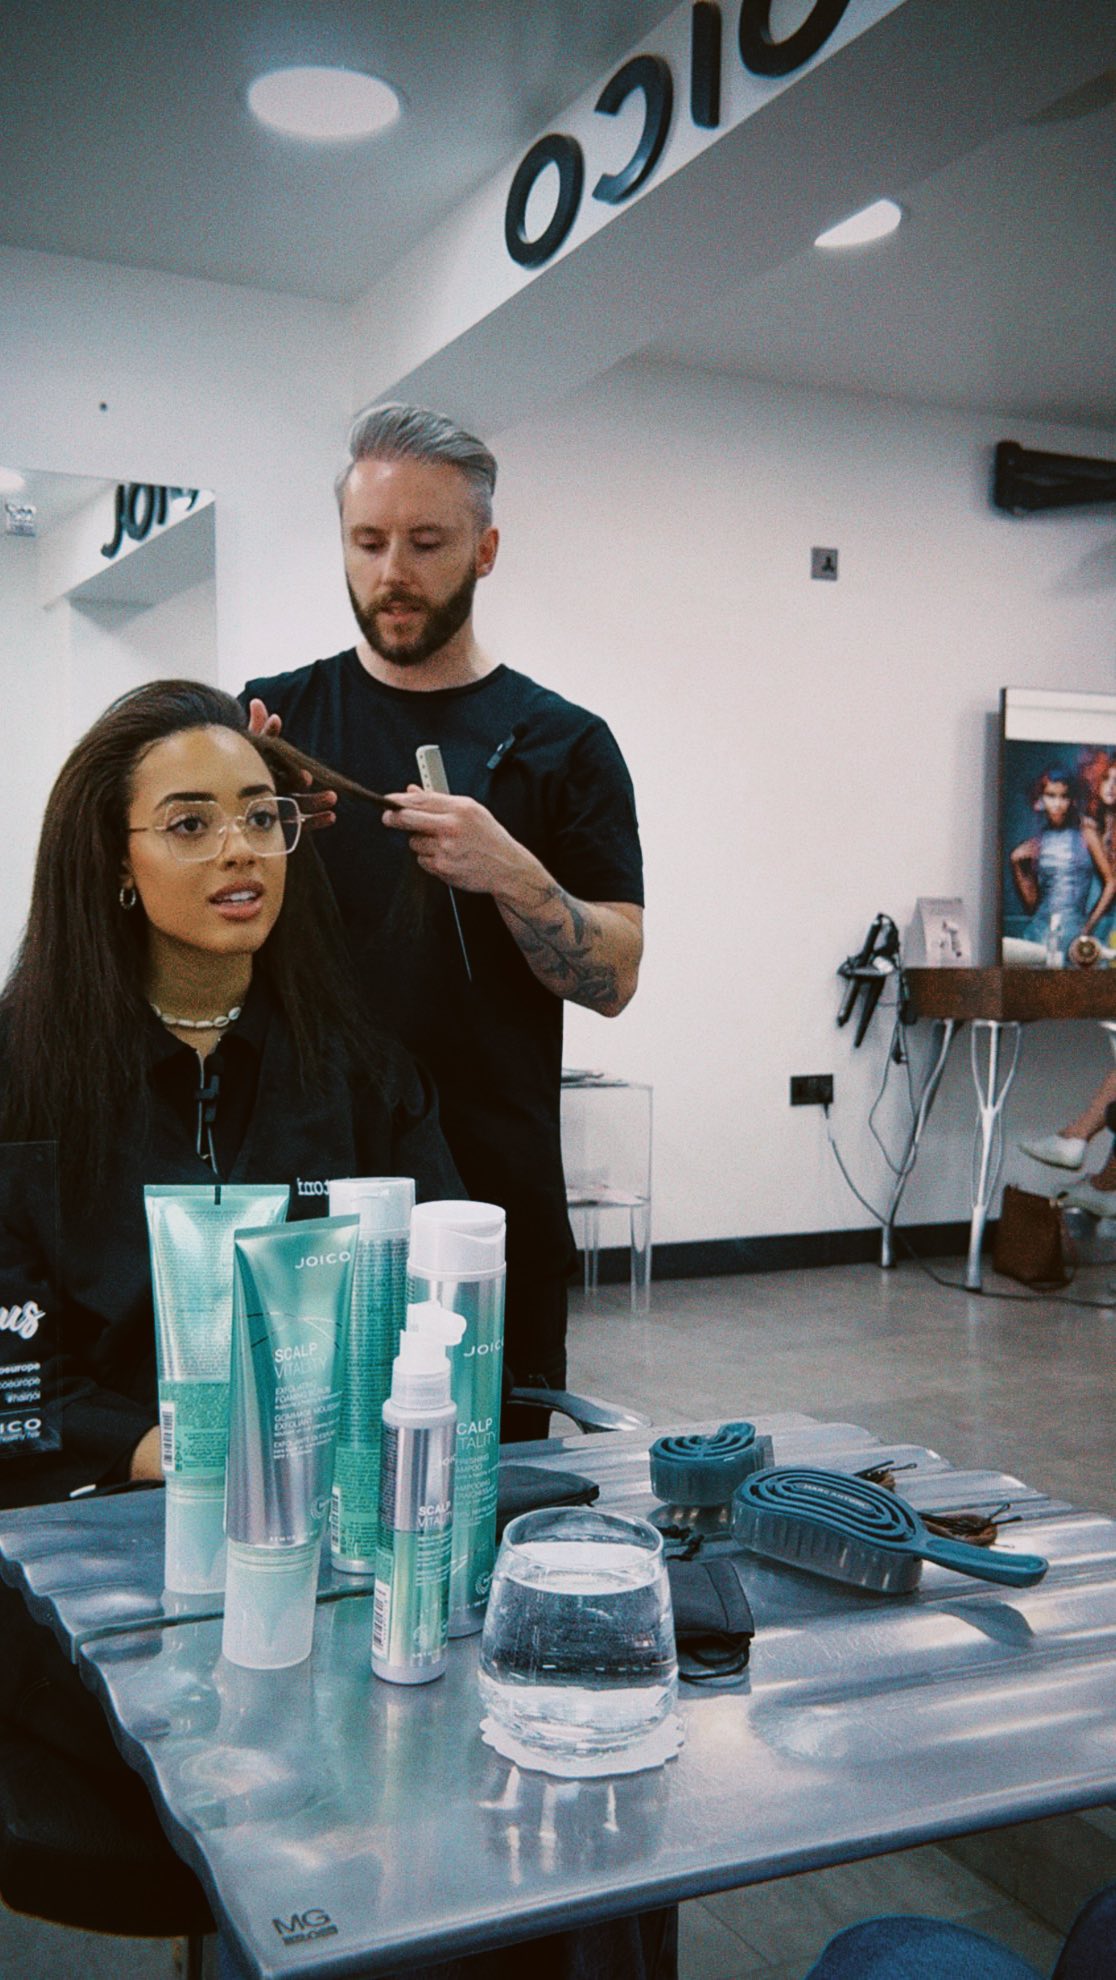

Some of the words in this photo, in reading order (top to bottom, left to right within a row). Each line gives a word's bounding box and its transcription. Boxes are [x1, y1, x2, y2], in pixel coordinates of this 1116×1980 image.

[294, 1251, 351, 1269] JOICO
[274, 1342, 318, 1363] SCALP
[274, 1354, 328, 1379] VITALITY
[456, 1417, 493, 1435] CALP
[457, 1431, 496, 1450] TALITY
